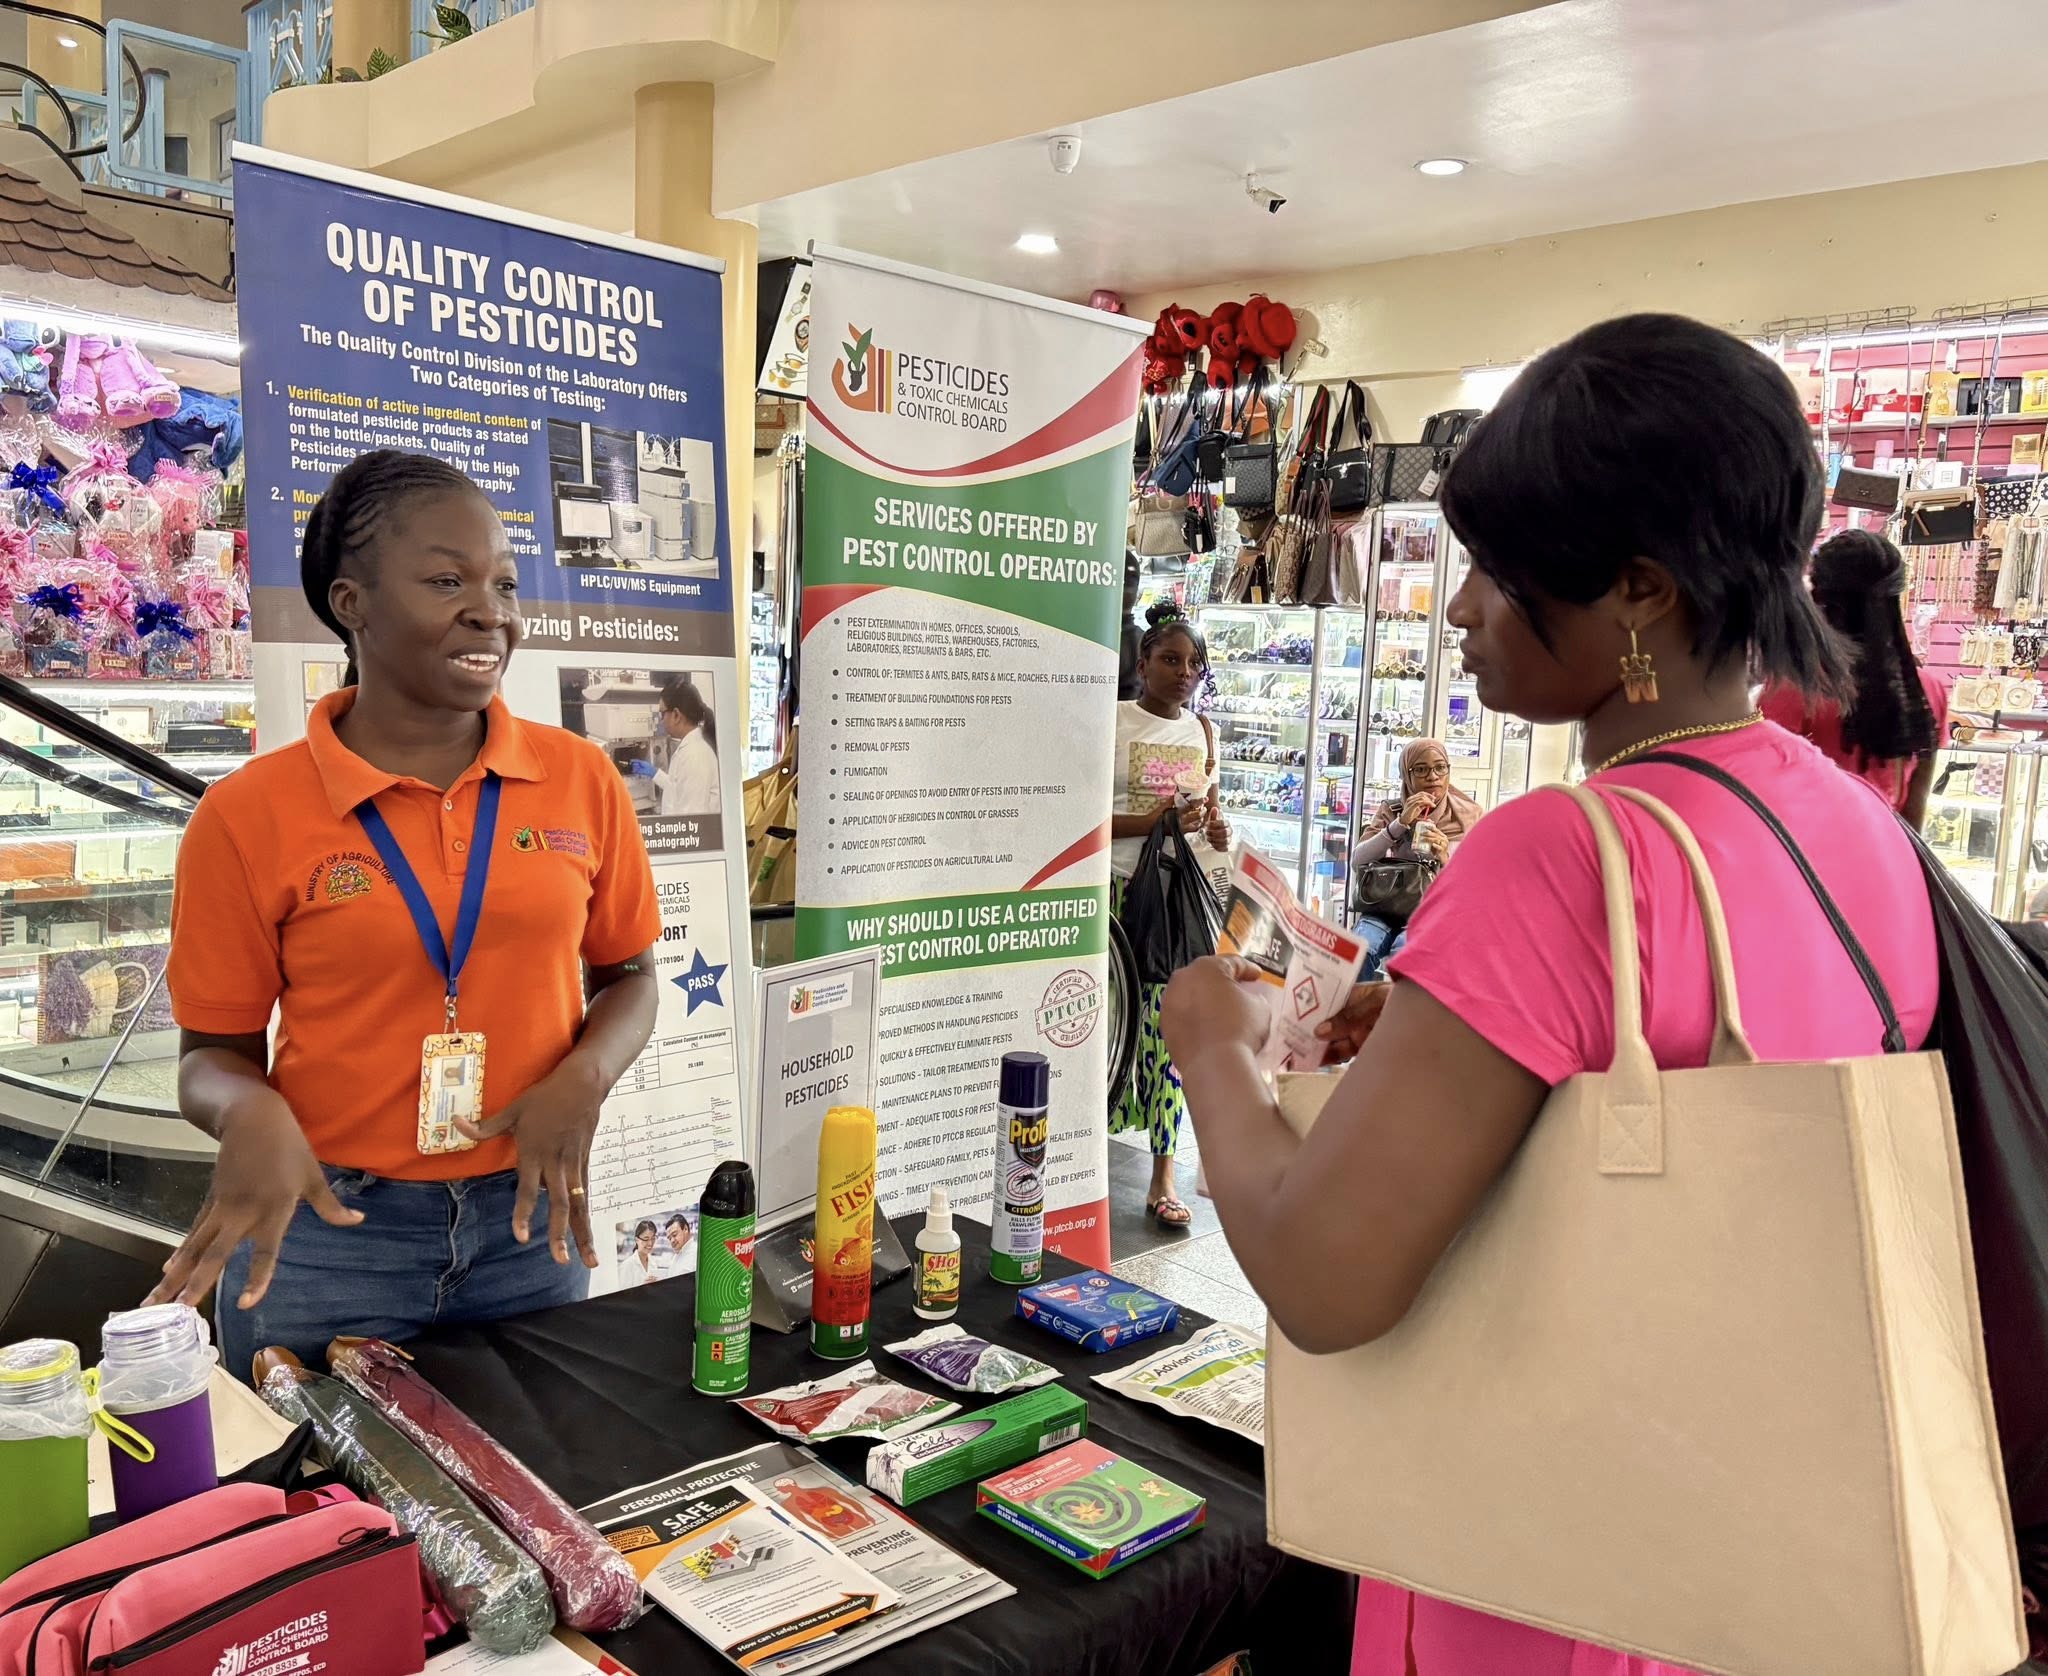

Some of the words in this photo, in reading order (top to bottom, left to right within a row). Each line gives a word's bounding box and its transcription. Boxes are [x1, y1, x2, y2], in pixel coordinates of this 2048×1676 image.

[326, 223, 490, 293] QUALITY
[504, 261, 663, 328] CONTROL
[364, 279, 414, 325] OF
[431, 292, 638, 366] PESTICIDES
[300, 323, 331, 345] The
[338, 330, 396, 359] Quality
[402, 341, 459, 366] Control
[465, 350, 523, 375] Division
[528, 360, 541, 378] of
[546, 363, 568, 382] the
[573, 367, 644, 398] Laboratory
[649, 382, 687, 403] Offers
[898, 353, 1009, 396] PESTICIDES
[266, 381, 279, 395] 1.
[411, 366, 442, 386] Two
[447, 370, 529, 400] Categories
[533, 381, 546, 400] of
[552, 386, 605, 411] Testing:
[898, 382, 906, 396] &
[910, 384, 943, 403] TOXIC
[946, 392, 1008, 414] CHEMICALS
[288, 385, 362, 408] Verification
[366, 396, 379, 409] of
[383, 400, 419, 415] active
[423, 404, 481, 424] ingredient
[485, 414, 528, 428] content
[531, 419, 541, 430] of
[897, 401, 957, 426] CONTROL
[961, 414, 1007, 433] BOARD
[288, 403, 358, 423] formulated
[363, 415, 419, 432] pesticide
[423, 422, 472, 440] products
[475, 429, 489, 440] as
[492, 430, 528, 445] stated
[290, 423, 304, 435] on
[311, 423, 330, 437] the
[334, 427, 426, 449] bottle/packets.
[430, 438, 470, 457] Quality
[474, 444, 484, 456] of
[291, 438, 356, 458] Pesticides
[471, 460, 489, 473] the
[493, 461, 520, 475] High
[271, 487, 284, 500] 2.
[874, 496, 972, 535] SERVICES
[978, 510, 1067, 544] OFFERED
[1074, 520, 1098, 546] BY
[843, 537, 898, 568] PEST
[903, 544, 995, 577] CONTROL
[1000, 553, 1117, 587] OPERATORS:
[581, 574, 646, 592] HPLC/UV/MS
[649, 580, 701, 596] Equipment
[579, 616, 679, 641] Pesticides:
[848, 617, 867, 628] PEST
[868, 618, 920, 630] EXTERMINATION
[921, 621, 927, 631] IN
[929, 622, 953, 632] HOMES,
[956, 623, 985, 634] OFFICES,
[987, 625, 1020, 636] SCHOOLS,
[844, 742, 878, 752] REMOVAL
[880, 742, 888, 752] OF
[890, 742, 910, 752] PESTS
[844, 766, 888, 777] FUMIGATION
[844, 790, 874, 802] SEALING
[876, 790, 884, 800] OF
[886, 789, 917, 800] OPENINGS
[919, 788, 927, 798] TO
[928, 788, 948, 798] AVOID
[949, 787, 970, 798] ENTRY
[971, 787, 980, 796] OF
[981, 786, 1002, 797] PESTS
[1003, 786, 1018, 796] INTO
[1020, 786, 1032, 795] THE
[1033, 785, 1066, 796] PREMISES
[655, 820, 686, 834] Sample
[689, 821, 698, 832] by
[305, 862, 326, 901] MINISTRY
[327, 854, 338, 864] OF
[841, 863, 885, 875] APPLICATION
[887, 862, 895, 871] OF
[896, 858, 932, 870] PESTICIDES
[934, 858, 944, 867] ON
[945, 854, 994, 866] AGRICULTURAL
[996, 854, 1012, 863] LAND
[664, 905, 690, 915] BOARD
[847, 916, 884, 942] WHY
[888, 909, 953, 936] SHOULD
[958, 908, 962, 928] I
[968, 906, 1000, 926] USE
[1004, 904, 1014, 924] A
[1019, 898, 1097, 922] CERTIFIED
[909, 938, 983, 963] CONTROL
[988, 926, 1080, 952] OPERATOR?
[688, 974, 714, 991] PASS
[1053, 976, 1082, 994] CERTIFIED
[880, 1001, 920, 1016] SPECIALISED
[922, 995, 964, 1009] KNOWLEDGE
[966, 995, 970, 1003] &
[973, 991, 1003, 1002] TRAINING
[1044, 993, 1096, 1025] PTCCB
[903, 1022, 935, 1034] METHODS
[946, 1016, 980, 1028] HANDLING
[982, 1011, 1018, 1024] PESTICIDES
[781, 1045, 854, 1080] HOUSEHOLD
[785, 1074, 849, 1108] PESTICIDES
[906, 1431, 950, 1453] Gold
[619, 1487, 688, 1512] PERSONAL
[686, 1462, 761, 1491] PROTECTIVE
[662, 1501, 717, 1530] SAFE
[671, 1516, 707, 1537] PESTICIDE
[707, 1499, 741, 1520] STORAGE
[875, 1535, 919, 1556] EXPOSURE
[249, 1610, 328, 1652] PESTICIDES
[256, 1640, 281, 1656] TOXIC
[281, 1624, 328, 1644] CHEMICALS
[737, 1641, 757, 1651] How
[757, 1634, 771, 1643] can
[776, 1623, 798, 1637] safely
[798, 1618, 818, 1628] store
[818, 1612, 830, 1622] my
[248, 1646, 292, 1668] CONTROL
[294, 1632, 329, 1650] BOARD
[275, 1658, 298, 1673] 8838
[313, 1662, 326, 1672] ECD
